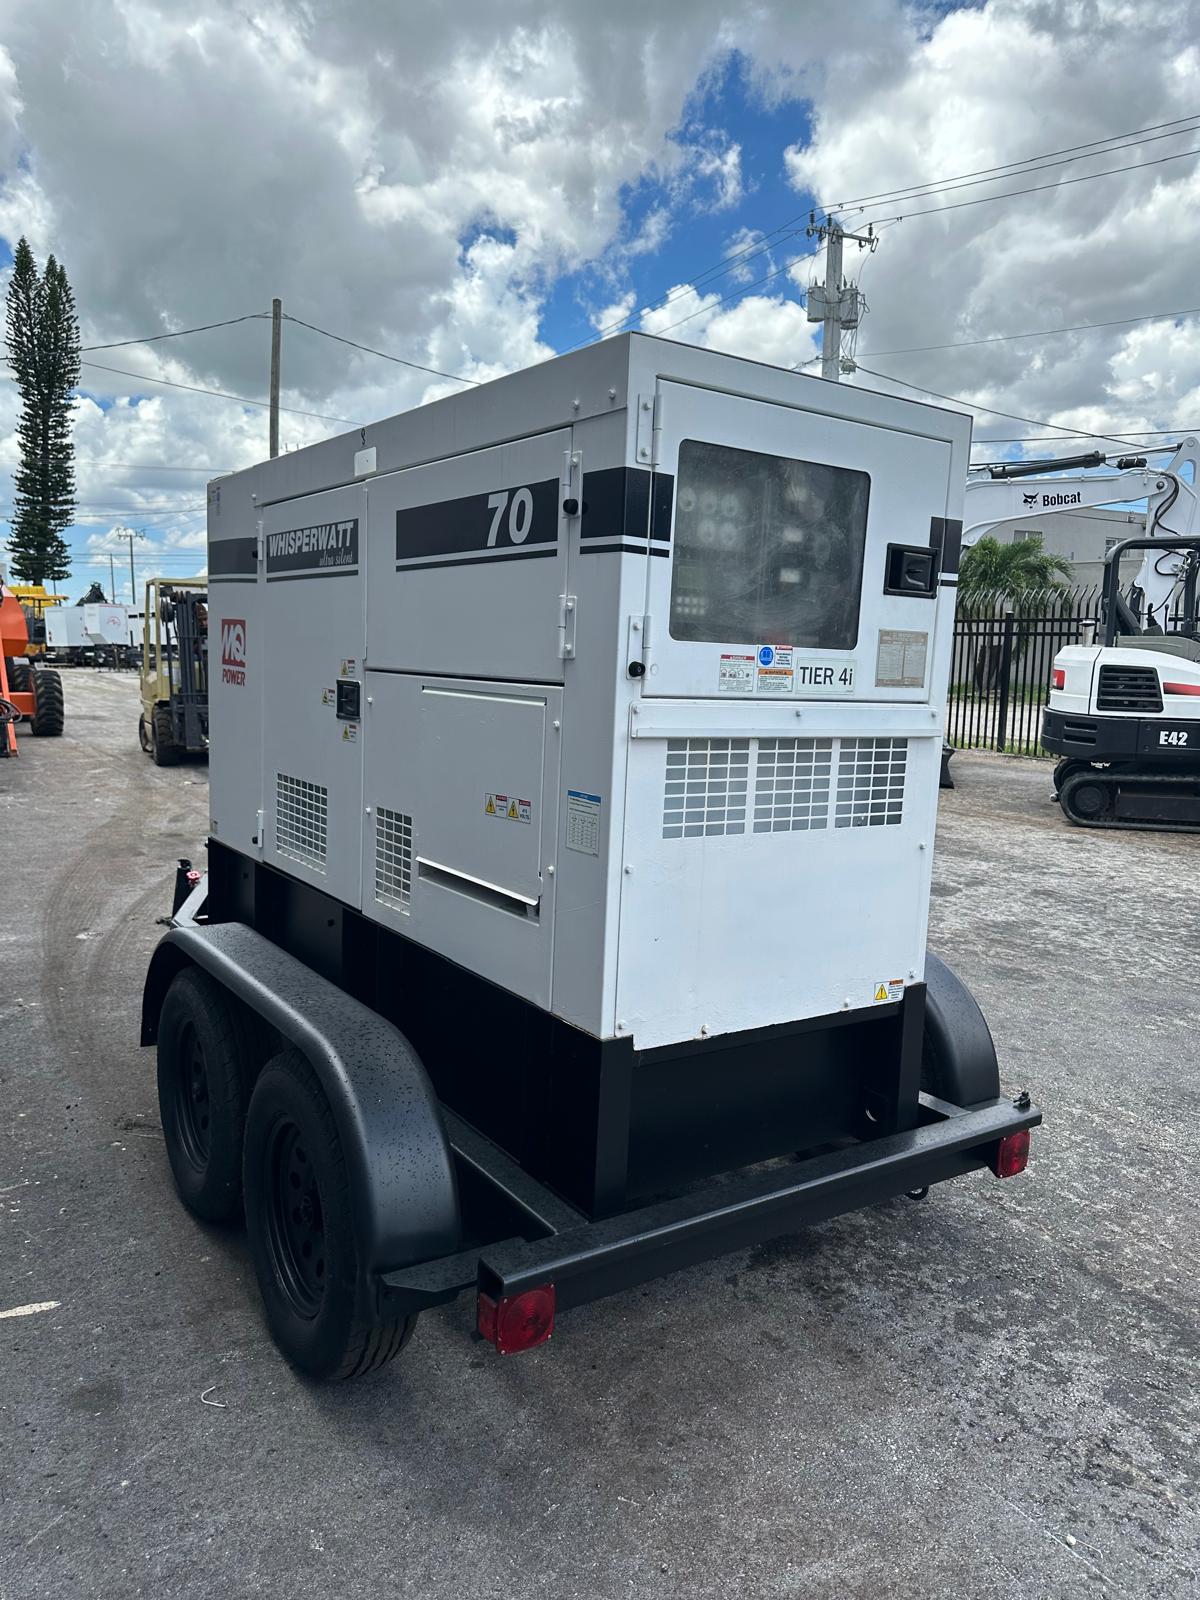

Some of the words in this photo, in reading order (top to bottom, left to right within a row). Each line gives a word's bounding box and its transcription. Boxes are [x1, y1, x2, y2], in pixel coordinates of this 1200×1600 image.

[1043, 491, 1082, 507] Bobcat
[487, 487, 533, 547] 70
[269, 521, 354, 557] WHISPERWATT
[319, 550, 334, 567] ultra
[335, 547, 353, 566] silent
[222, 671, 246, 687] POWER
[800, 666, 834, 685] TIER
[838, 667, 853, 686] 4i
[1159, 730, 1188, 746] E42
